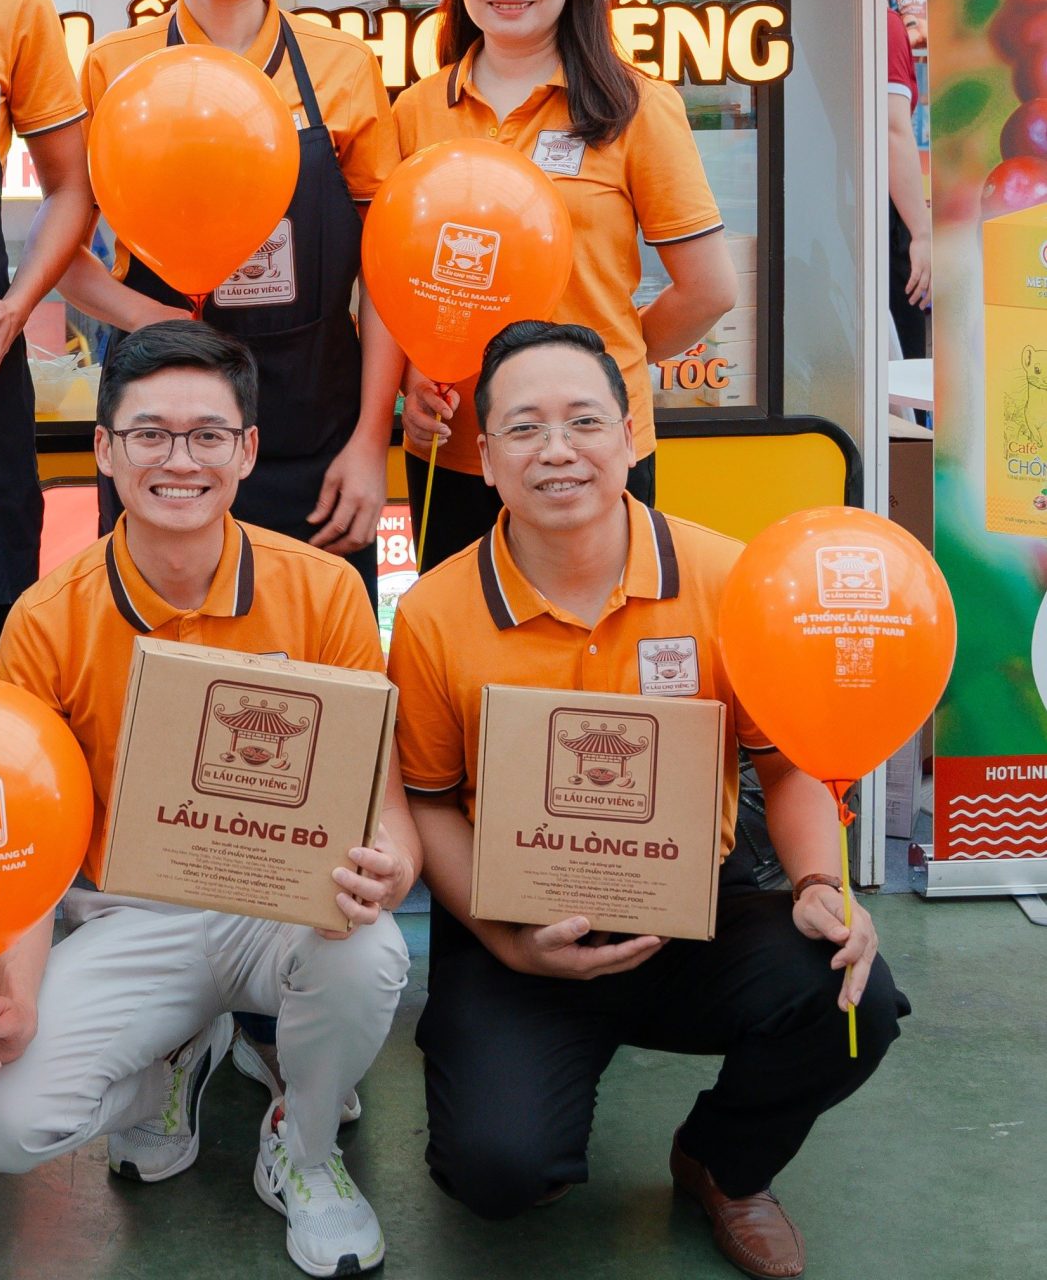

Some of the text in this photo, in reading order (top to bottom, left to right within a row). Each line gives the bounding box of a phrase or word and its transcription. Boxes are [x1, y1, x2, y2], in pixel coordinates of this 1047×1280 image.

[658, 344, 731, 390] TỐC
[1009, 441, 1037, 454] Café
[377, 516, 405, 531] NH
[156, 799, 329, 849] LẨU LÒNG BÒ
[515, 823, 680, 861] LẨU LÒNG BÒ
